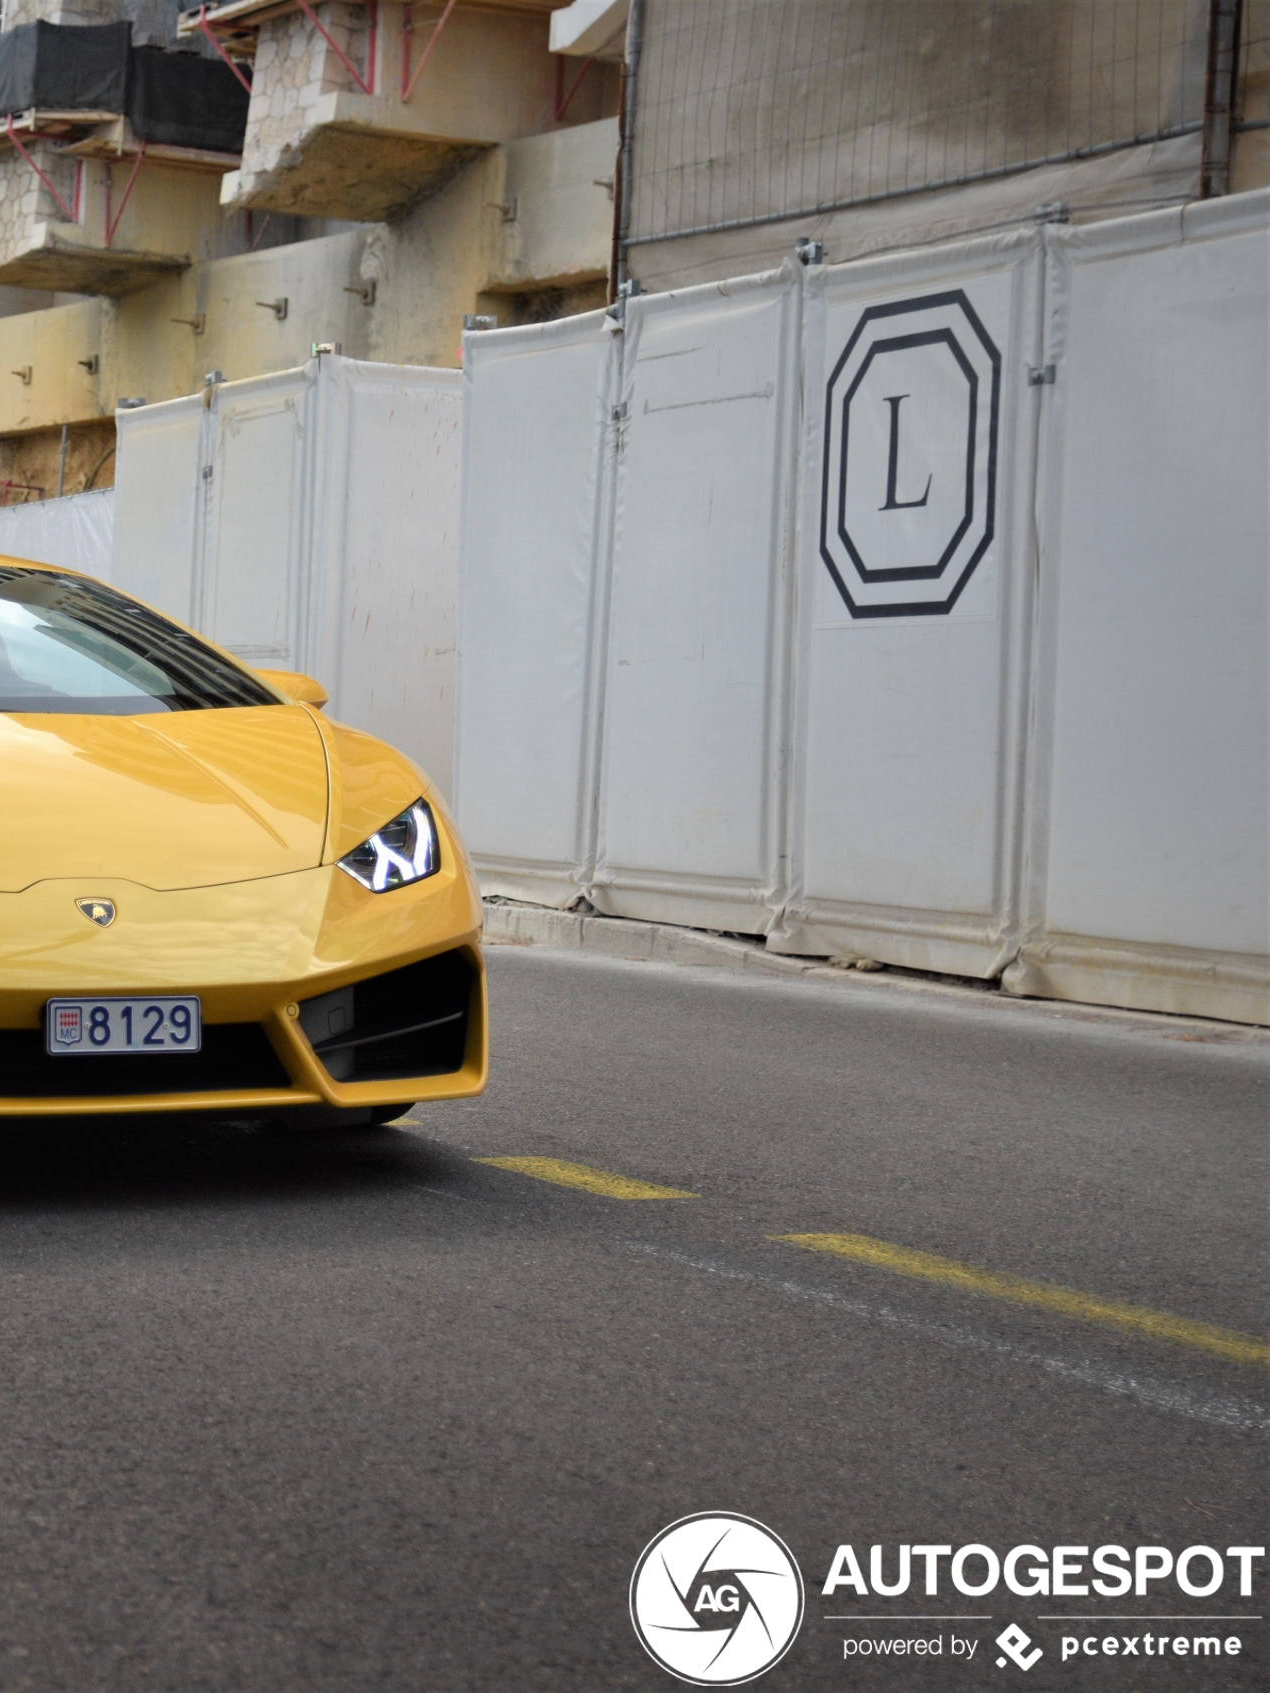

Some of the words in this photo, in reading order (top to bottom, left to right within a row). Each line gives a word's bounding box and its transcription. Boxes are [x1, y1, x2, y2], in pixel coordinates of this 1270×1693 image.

[878, 394, 933, 511] L
[60, 1028, 78, 1039] MC
[89, 1004, 192, 1046] 8129
